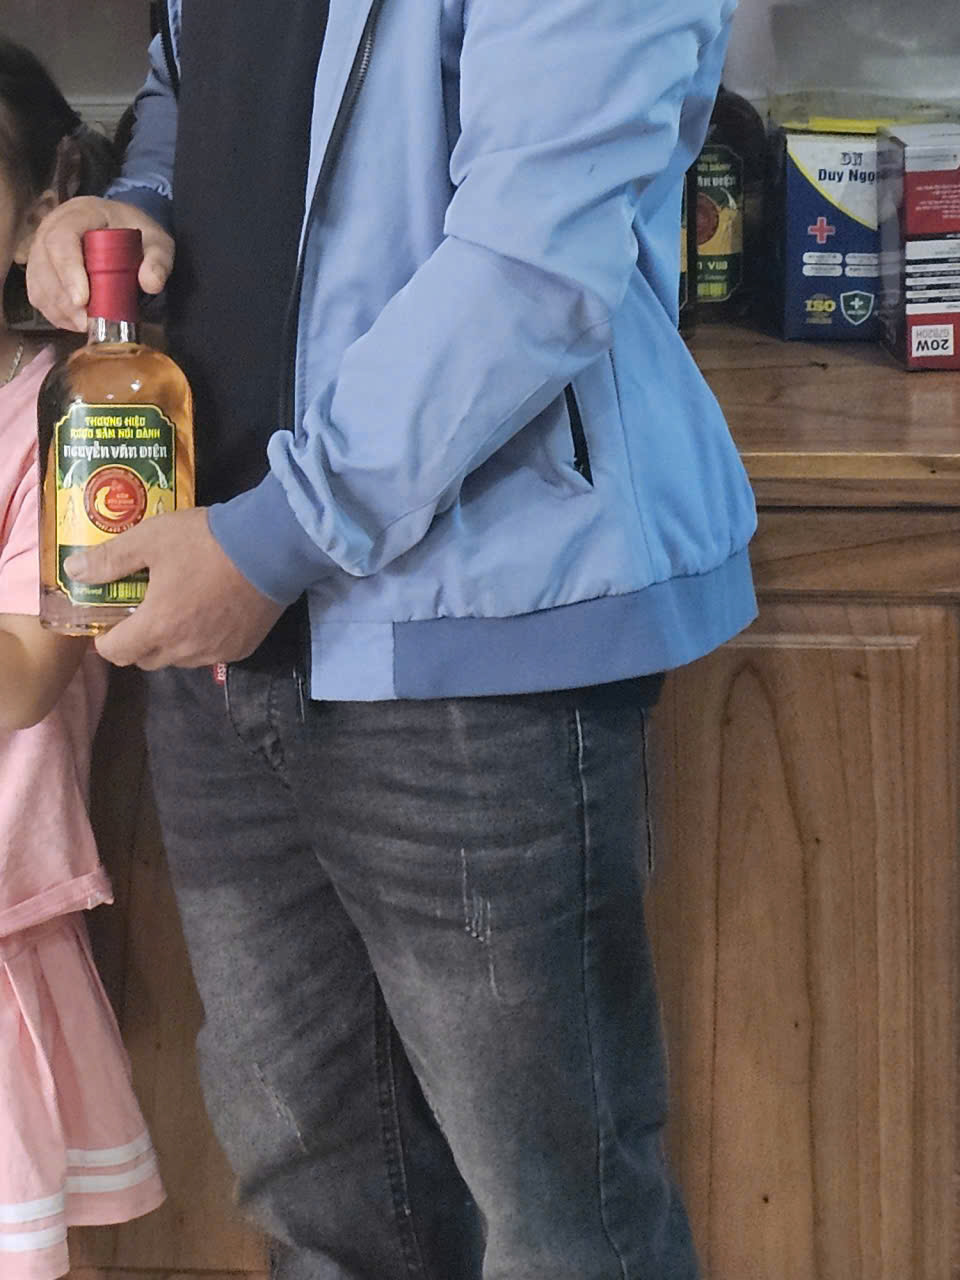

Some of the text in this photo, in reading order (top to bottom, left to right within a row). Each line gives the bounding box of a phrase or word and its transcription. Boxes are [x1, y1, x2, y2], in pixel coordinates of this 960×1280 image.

[818, 168, 880, 184] Duy Ngọ
[915, 339, 950, 352] 20W
